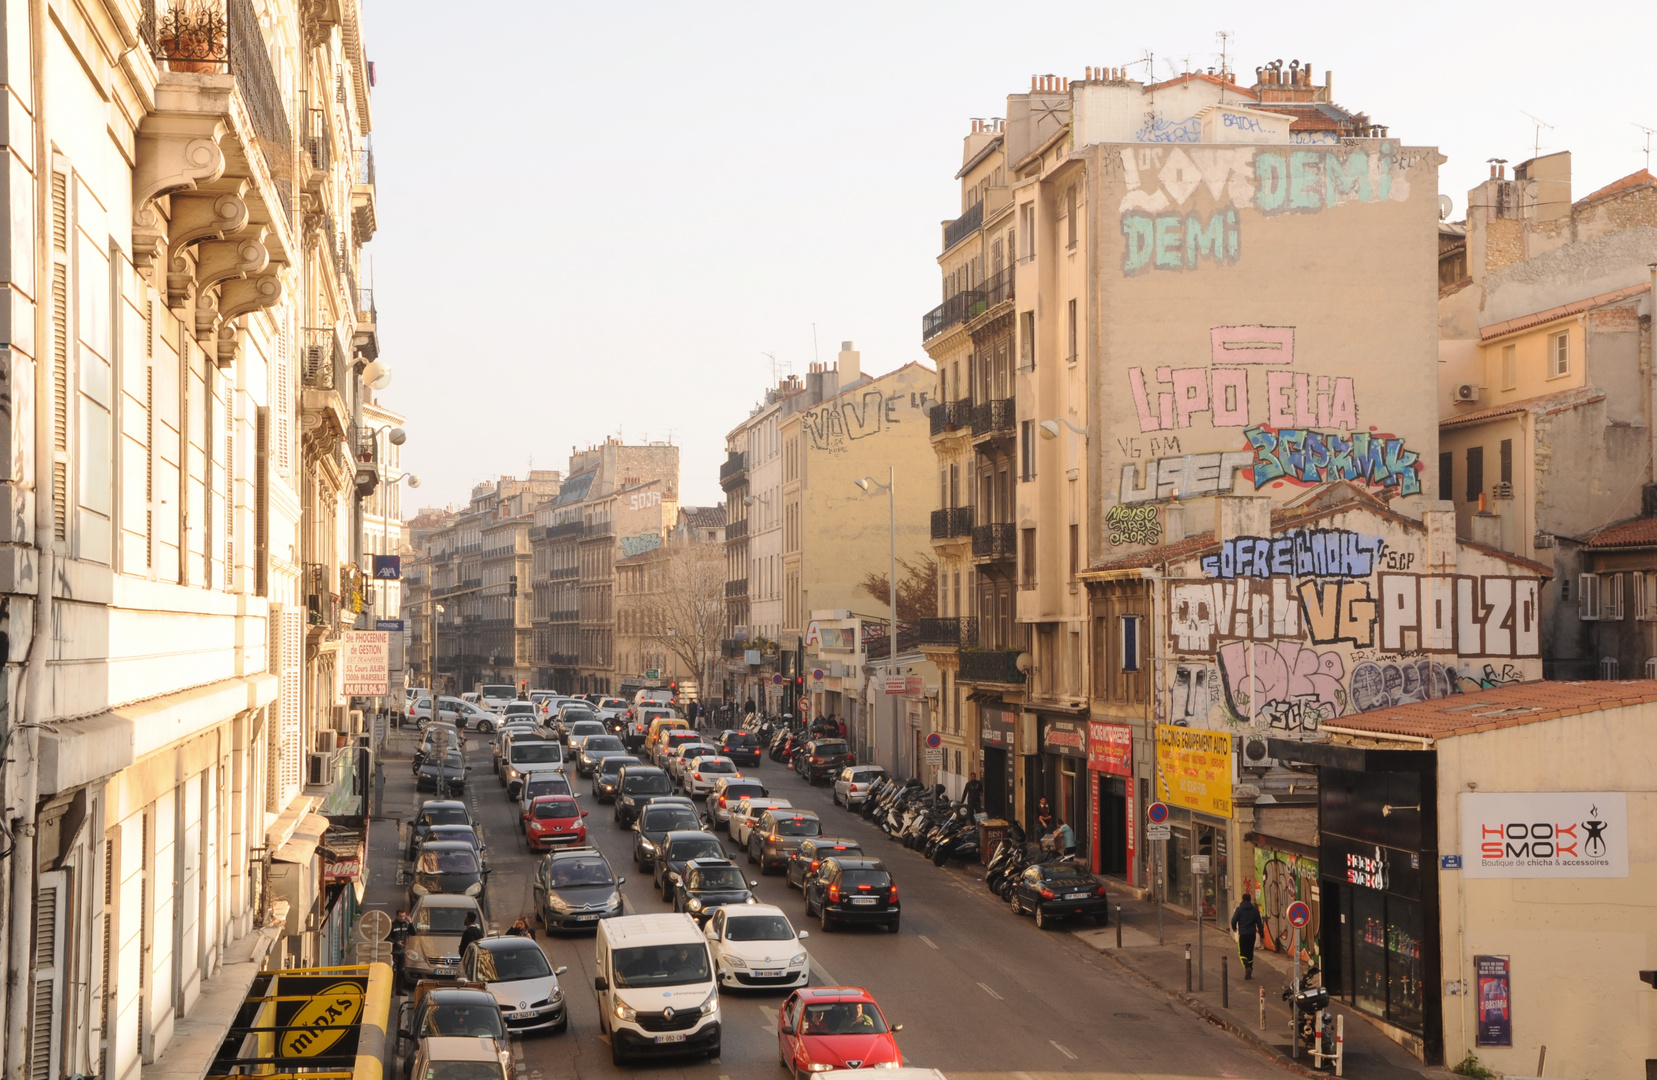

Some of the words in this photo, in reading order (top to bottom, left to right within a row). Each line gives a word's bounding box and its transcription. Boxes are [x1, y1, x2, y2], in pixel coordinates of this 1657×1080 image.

[377, 567, 396, 577] AXA
[350, 645, 357, 655] de
[358, 645, 382, 655] GESTION
[355, 665, 368, 673] Cours
[369, 665, 385, 673] JULIEN
[1214, 736, 1228, 755] AUTO
[1481, 823, 1578, 840] HOOK
[1481, 841, 1578, 859] SMOK
[1481, 859, 1514, 867] Boutique
[1516, 859, 1526, 867] de
[1527, 859, 1553, 867] chicha
[1562, 859, 1609, 867] accessoires
